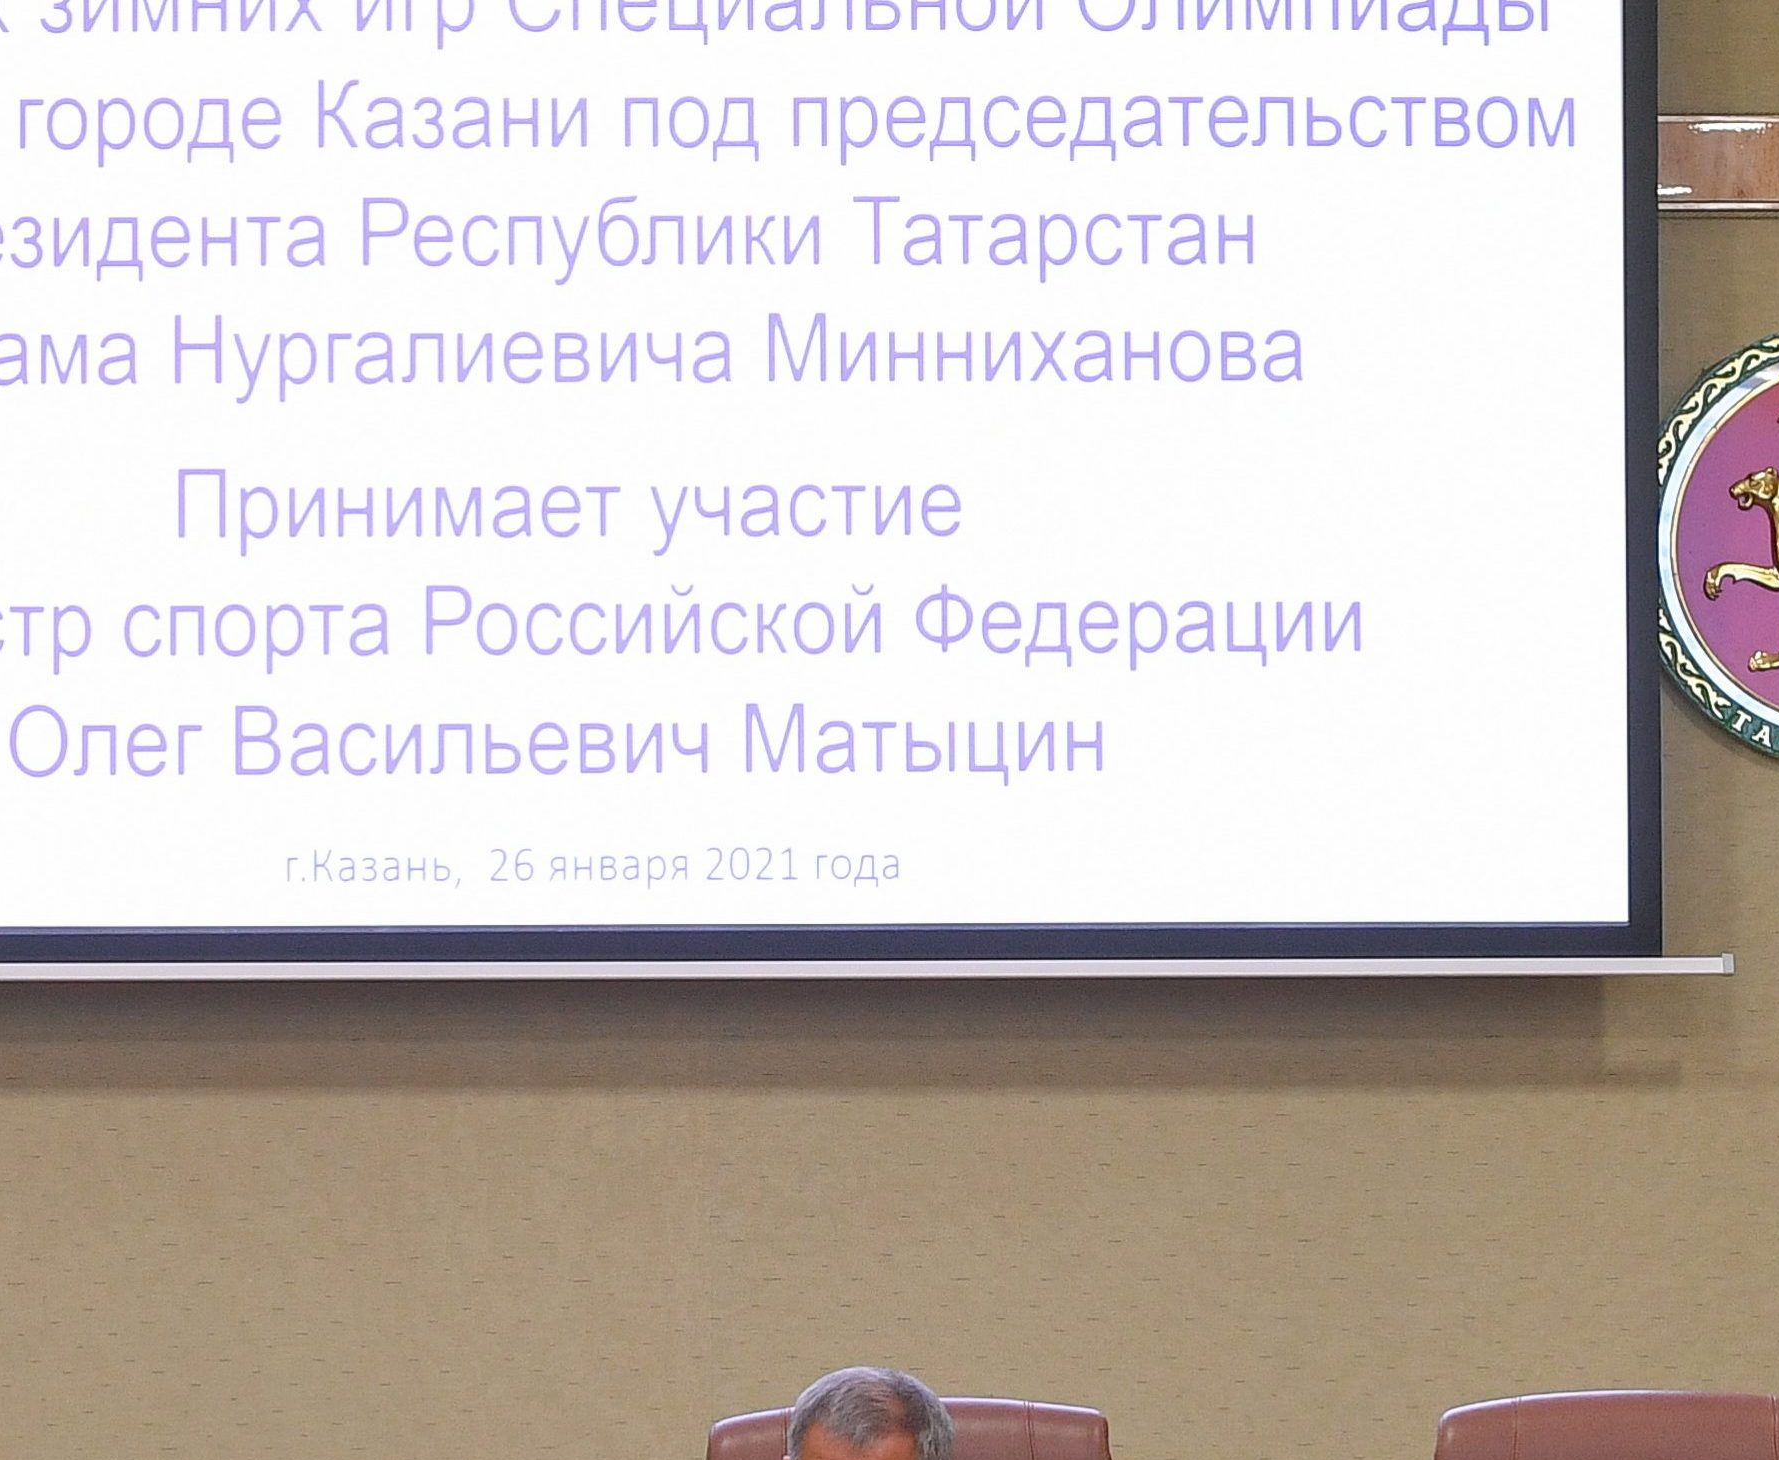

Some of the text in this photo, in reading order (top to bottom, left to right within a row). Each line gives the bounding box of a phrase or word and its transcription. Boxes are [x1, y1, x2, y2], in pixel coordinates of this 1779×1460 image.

[40, 0, 323, 34] зимних
[356, 0, 475, 50] игр
[20, 97, 282, 168] городе
[318, 80, 587, 149] Казани
[624, 96, 759, 162] под
[793, 95, 1575, 166] председательством
[362, 195, 820, 286] Республики
[853, 196, 1254, 284] Татарстан
[174, 314, 731, 404] Нургалиевича
[768, 313, 1303, 383] Минниханова
[178, 468, 961, 557] Принимает участие
[124, 603, 389, 675] спорта
[426, 584, 881, 656] Российской
[916, 584, 1361, 671] Федерации
[9, 703, 1103, 786] Олег Васильевич Матыцин
[490, 848, 534, 882] 26
[550, 855, 688, 889] января
[707, 847, 799, 881] 2021
[816, 854, 900, 888] года
